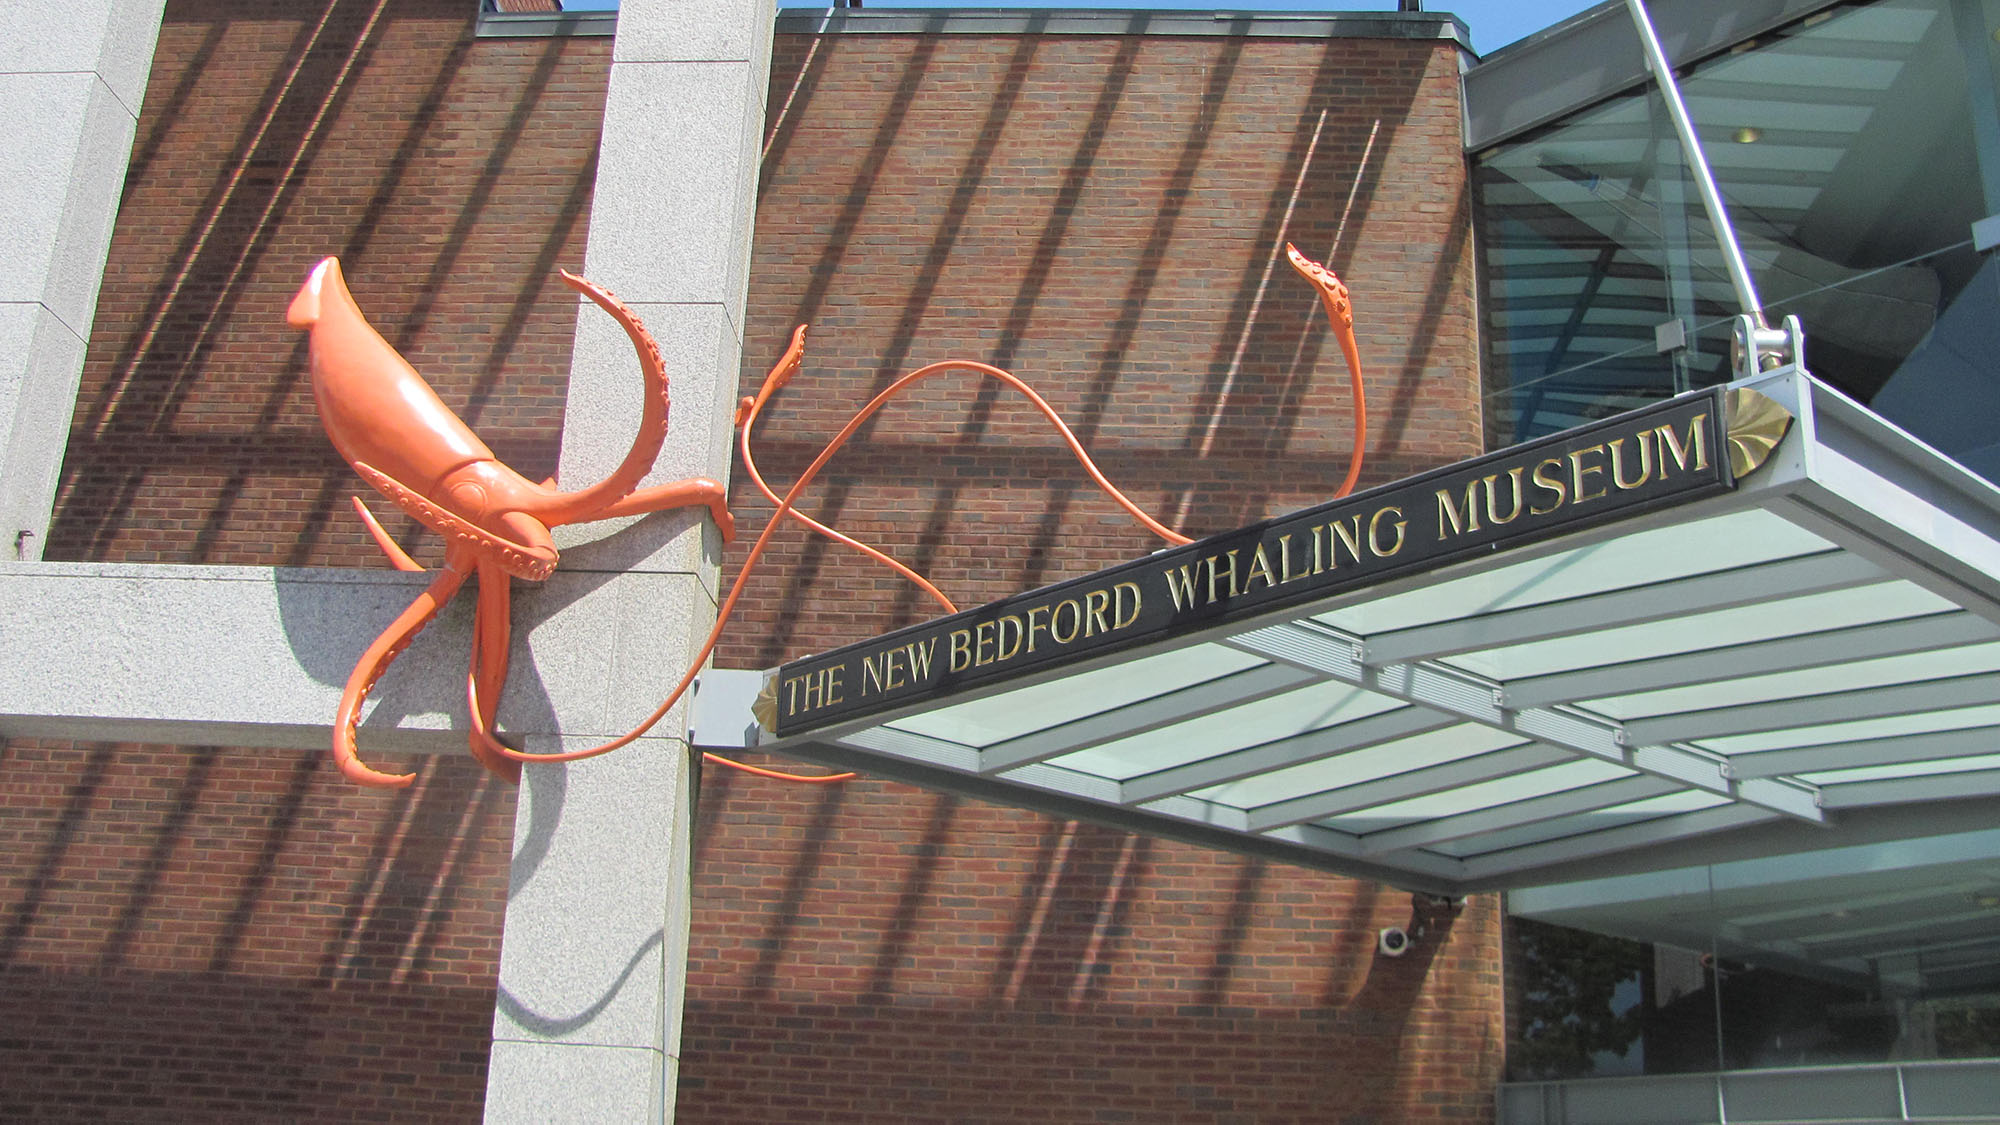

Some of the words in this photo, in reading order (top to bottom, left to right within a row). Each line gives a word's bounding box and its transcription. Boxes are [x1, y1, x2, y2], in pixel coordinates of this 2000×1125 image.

[784, 664, 845, 716] THE
[862, 637, 938, 697] NEW
[949, 581, 1142, 673] BEDFORD
[1164, 506, 1408, 613] WHALING
[1435, 414, 1709, 540] MUSEUM
